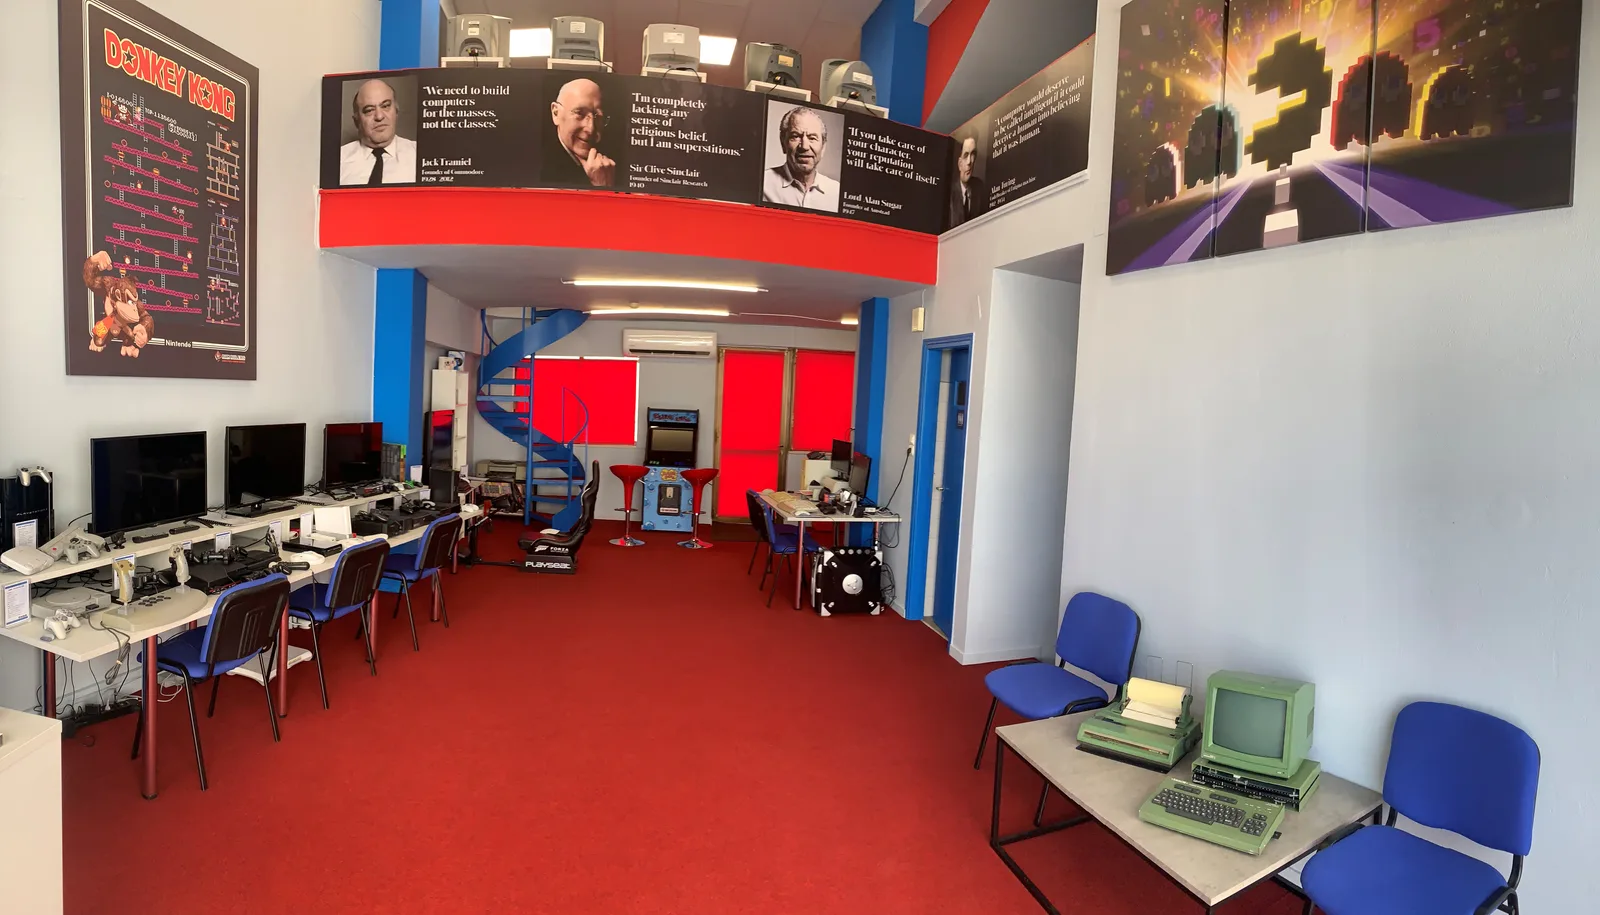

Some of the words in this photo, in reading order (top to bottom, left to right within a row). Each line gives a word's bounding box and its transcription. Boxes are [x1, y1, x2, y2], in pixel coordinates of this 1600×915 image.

[104, 28, 186, 98] DONKEY
[188, 70, 235, 122] KONG
[444, 85, 468, 95] need
[471, 87, 480, 95] to
[482, 85, 510, 95] build
[422, 98, 475, 109] computers
[652, 98, 706, 111] completely
[1000, 104, 1026, 124] computer
[1027, 89, 1044, 106] would
[1045, 76, 1069, 95] deserve
[1000, 125, 1006, 134] be
[1007, 113, 1023, 130] called
[1024, 97, 1053, 122] intelligent
[1054, 91, 1059, 102] if
[1060, 88, 1064, 98] it
[1065, 75, 1085, 94] could
[423, 108, 438, 117] for
[439, 108, 456, 117] the
[632, 104, 669, 118] lacking
[670, 110, 689, 120] any
[441, 119, 457, 128] the
[631, 117, 660, 125] sense
[662, 118, 673, 127] of
[993, 133, 1011, 149] deceive
[1017, 118, 1037, 134] human
[1038, 110, 1050, 123] into
[1050, 93, 1081, 116] believing
[631, 126, 676, 138] religious
[631, 137, 648, 146] but
[650, 137, 654, 147] I
[674, 142, 744, 156] superstitious."
[847, 139, 868, 148] your
[860, 132, 876, 140] you
[878, 135, 896, 146] take
[897, 141, 915, 151] care
[917, 145, 927, 153] of
[993, 148, 1003, 159] that
[1003, 144, 1008, 152] it
[1008, 140, 1018, 149] was
[422, 158, 438, 167] Jack
[440, 158, 471, 166] Tramiel
[847, 149, 868, 158] your
[870, 153, 914, 170] reputation
[630, 164, 644, 172] Sir
[644, 165, 665, 174] Clive
[666, 167, 700, 178] Sinclair
[847, 158, 863, 168] will
[866, 162, 884, 172] take
[885, 167, 903, 177] care
[905, 171, 914, 180] of
[844, 192, 862, 201] Lord
[863, 196, 880, 205] Alan
[881, 200, 903, 210] Sugar
[166, 339, 191, 348] Nintendo
